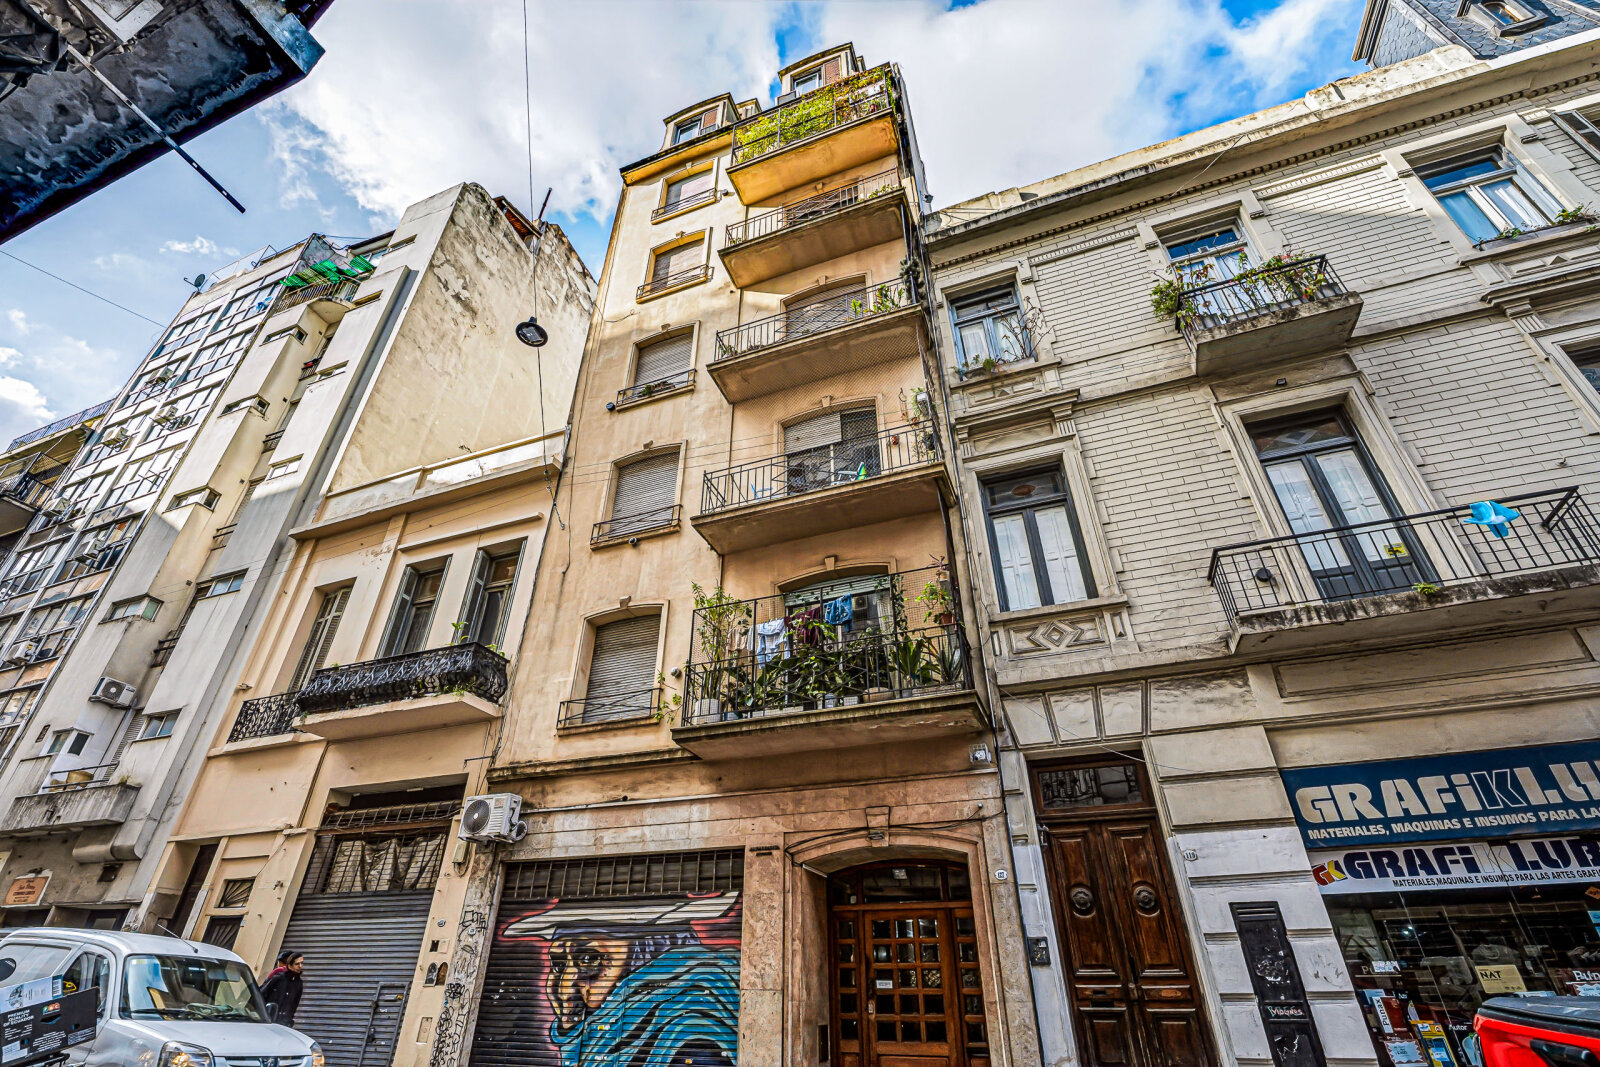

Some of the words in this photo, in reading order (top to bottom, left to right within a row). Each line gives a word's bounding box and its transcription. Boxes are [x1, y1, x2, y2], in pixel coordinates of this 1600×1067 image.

[1307, 824, 1390, 840] MATERIALES,
[1391, 818, 1462, 834] MAQUINAS
[1463, 818, 1474, 828] E
[1474, 812, 1537, 827] INSUMOS
[1538, 809, 1580, 822] PARA
[1580, 807, 1600, 819] LA
[1475, 875, 1481, 883] E
[1481, 874, 1516, 883] INSUMOS
[1516, 873, 1534, 882] PARA
[1535, 872, 1551, 880] LAS
[1551, 870, 1577, 880] ARTES
[1480, 970, 1501, 979] NAT
[7, 1009, 30, 1018] PREMIUM
[8, 1013, 29, 1022] QUALITY
